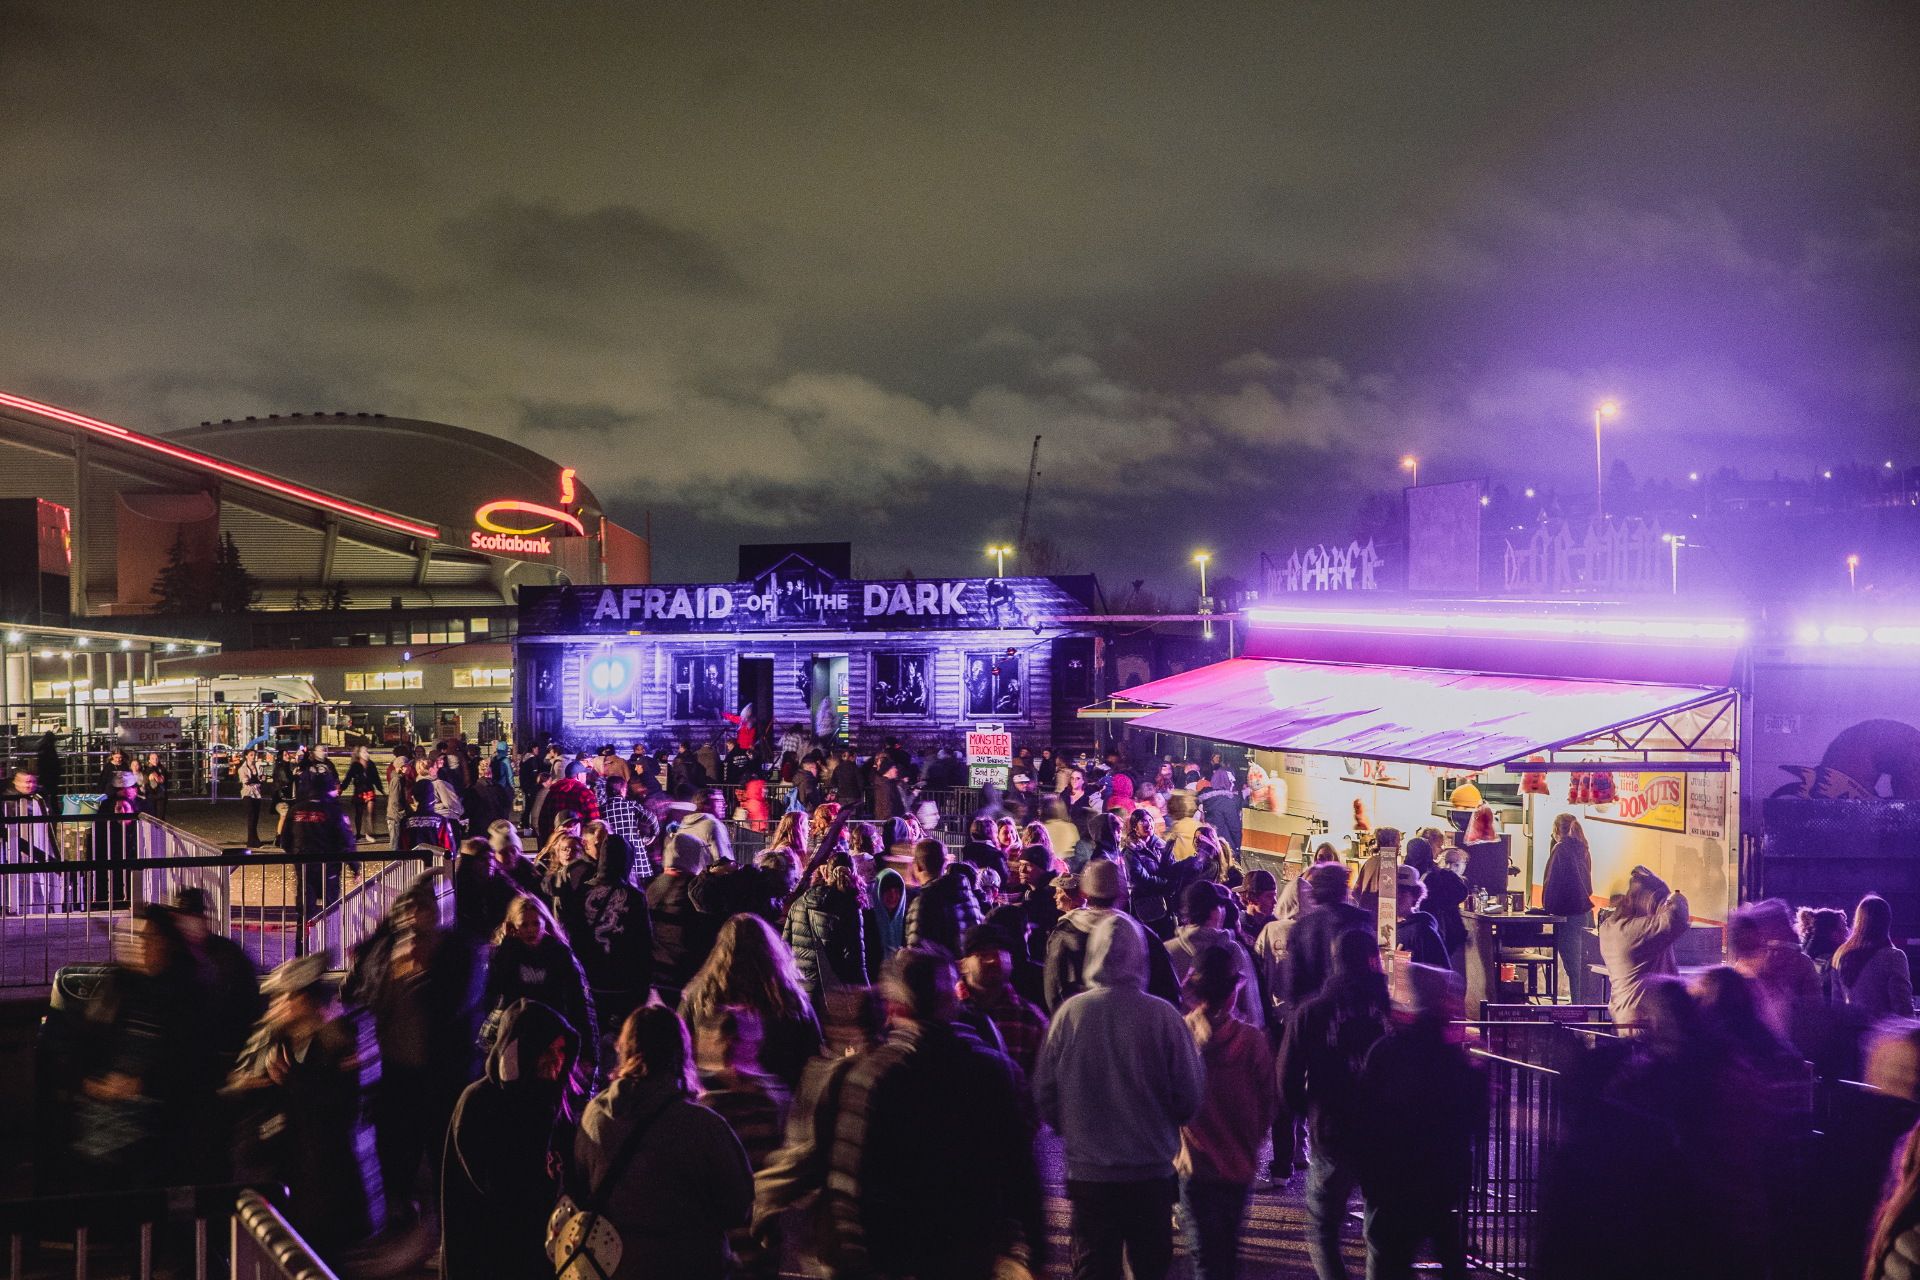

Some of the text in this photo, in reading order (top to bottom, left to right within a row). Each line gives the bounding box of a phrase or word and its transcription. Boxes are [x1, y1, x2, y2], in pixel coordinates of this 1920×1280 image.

[471, 531, 551, 554] Scotiabank
[593, 582, 968, 620] AFRAID OF THE DARK
[120, 720, 179, 730] EMERGENCY
[139, 732, 161, 741] EXIT
[969, 734, 1008, 746] MONSTER
[969, 745, 1009, 756] TRUCK RIDE
[1620, 779, 1639, 792] little
[1691, 778, 1710, 788] JUMBO
[1619, 780, 1680, 818] DONUTS
[1691, 792, 1710, 803] COMBO
[406, 818, 440, 829] SECURITY
[1700, 829, 1720, 837] INCLUDED
